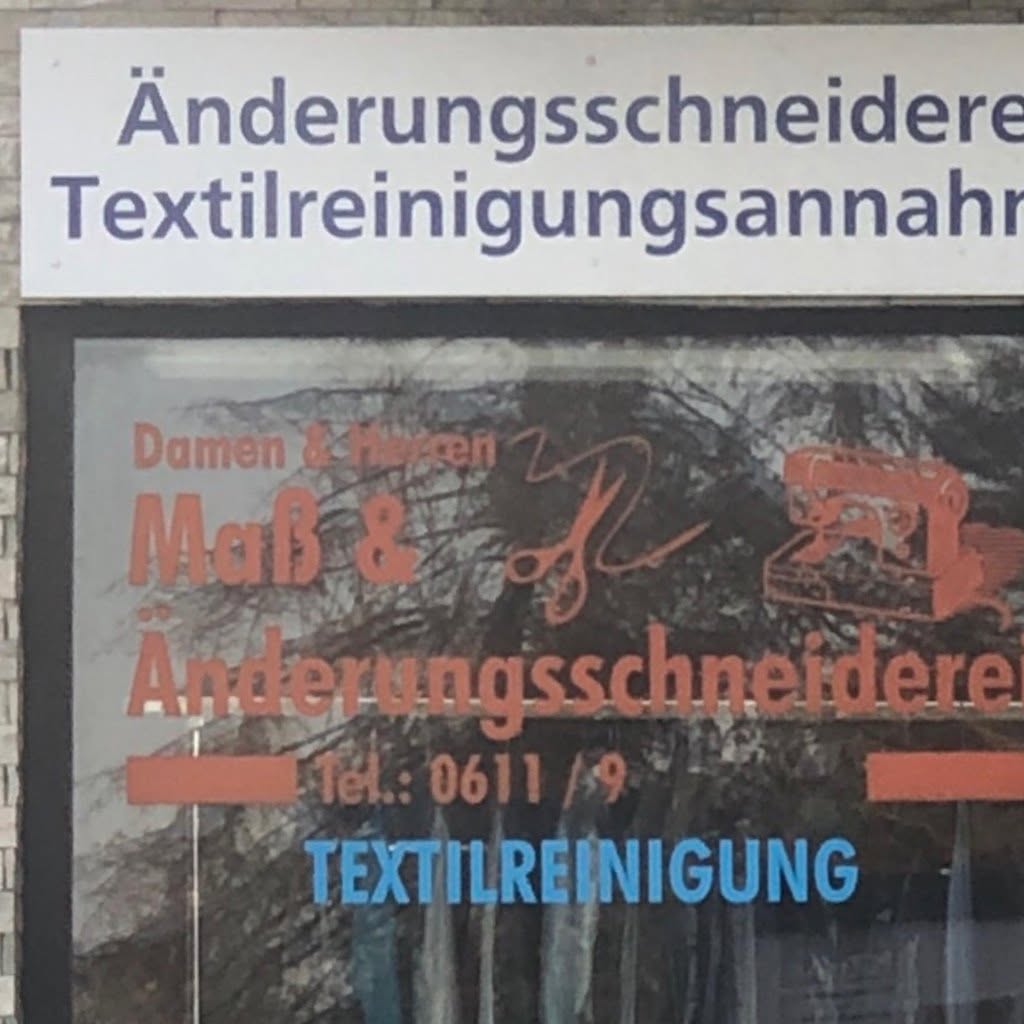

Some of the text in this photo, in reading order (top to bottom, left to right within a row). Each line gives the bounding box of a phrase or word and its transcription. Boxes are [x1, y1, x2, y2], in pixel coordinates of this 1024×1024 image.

[134, 420, 496, 470] Damen & Herren
[128, 487, 418, 586] Maß &
[316, 751, 412, 804] Tel.:
[430, 753, 541, 804] 0611
[600, 752, 627, 803] 9
[304, 838, 860, 906] TEXTILREINIGUNG
